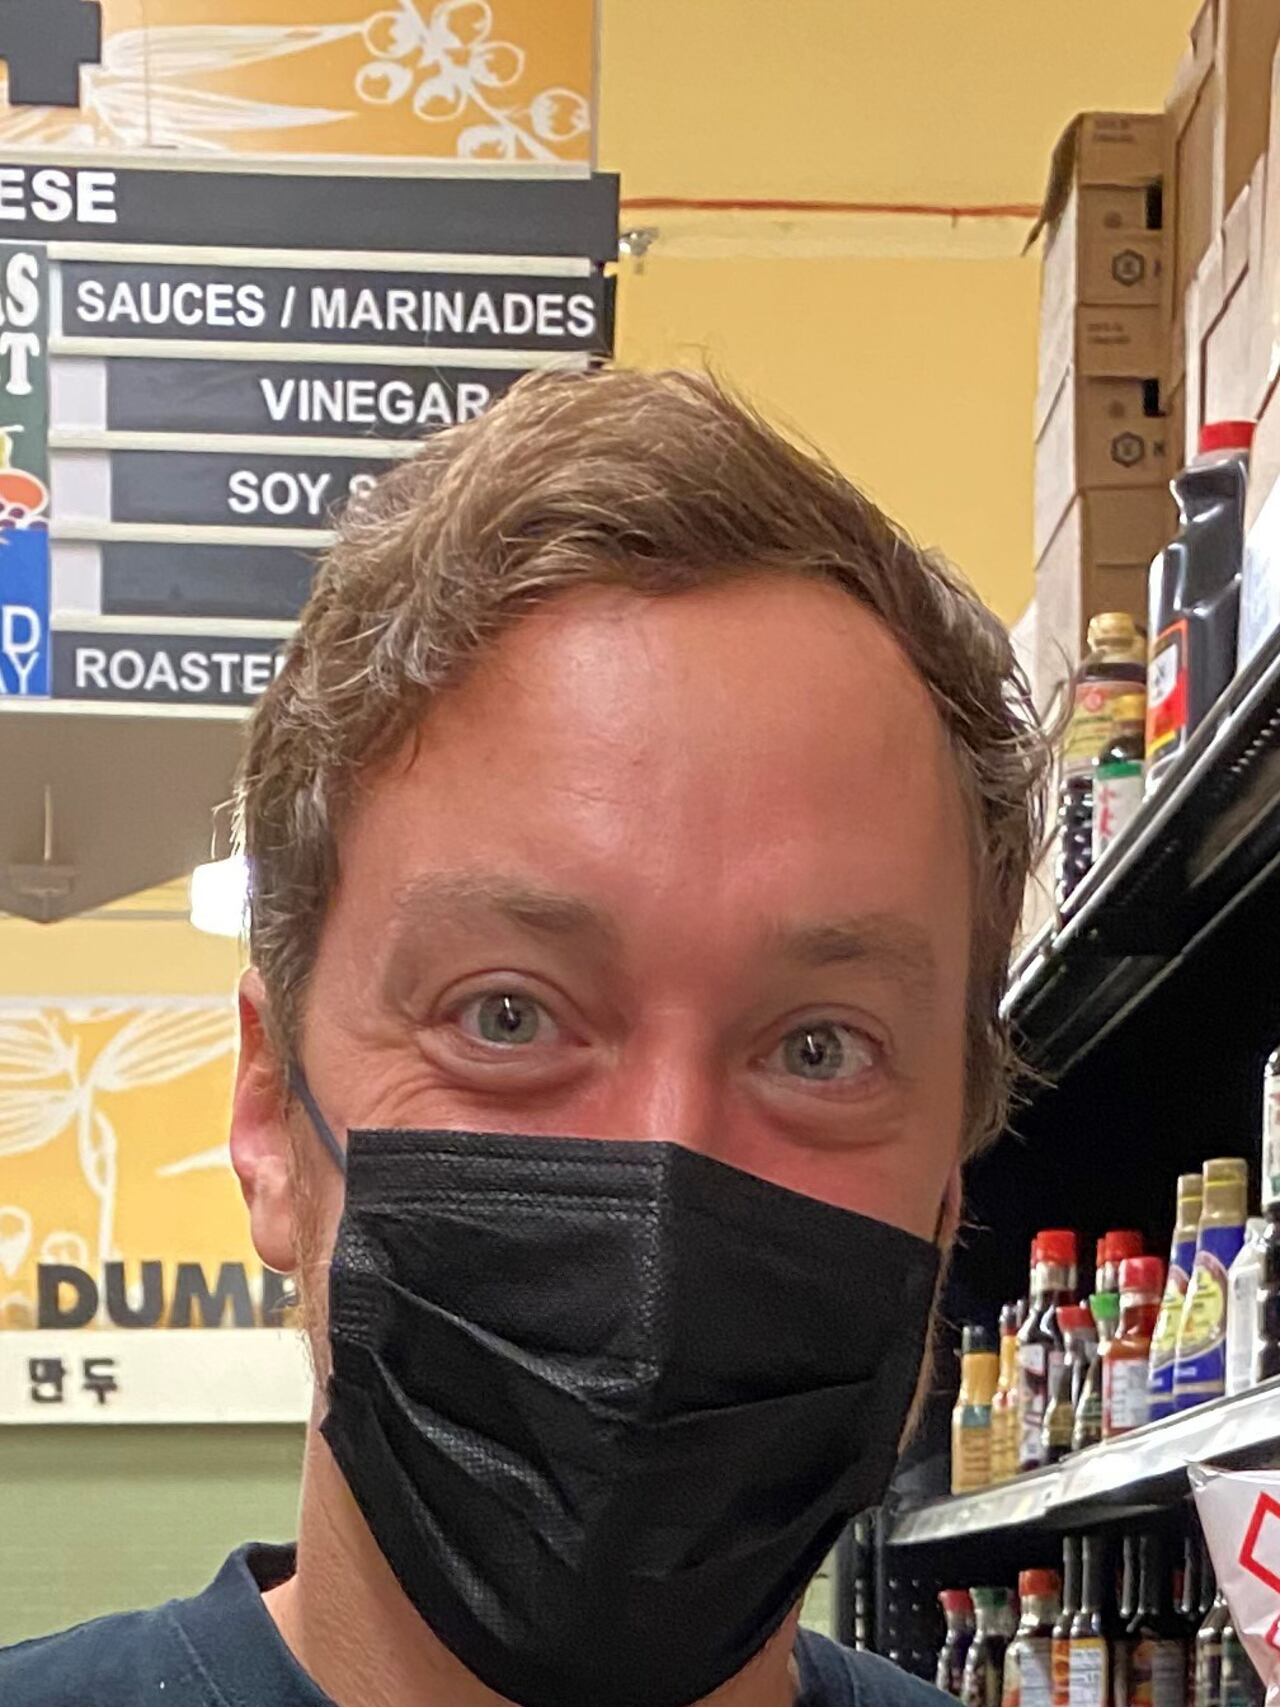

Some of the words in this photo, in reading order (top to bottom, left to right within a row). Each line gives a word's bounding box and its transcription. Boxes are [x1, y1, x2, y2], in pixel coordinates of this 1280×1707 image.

[76, 279, 266, 328] SAUCES
[279, 286, 296, 328] /
[310, 287, 597, 338] MARINADES
[227, 470, 331, 515] SOY
